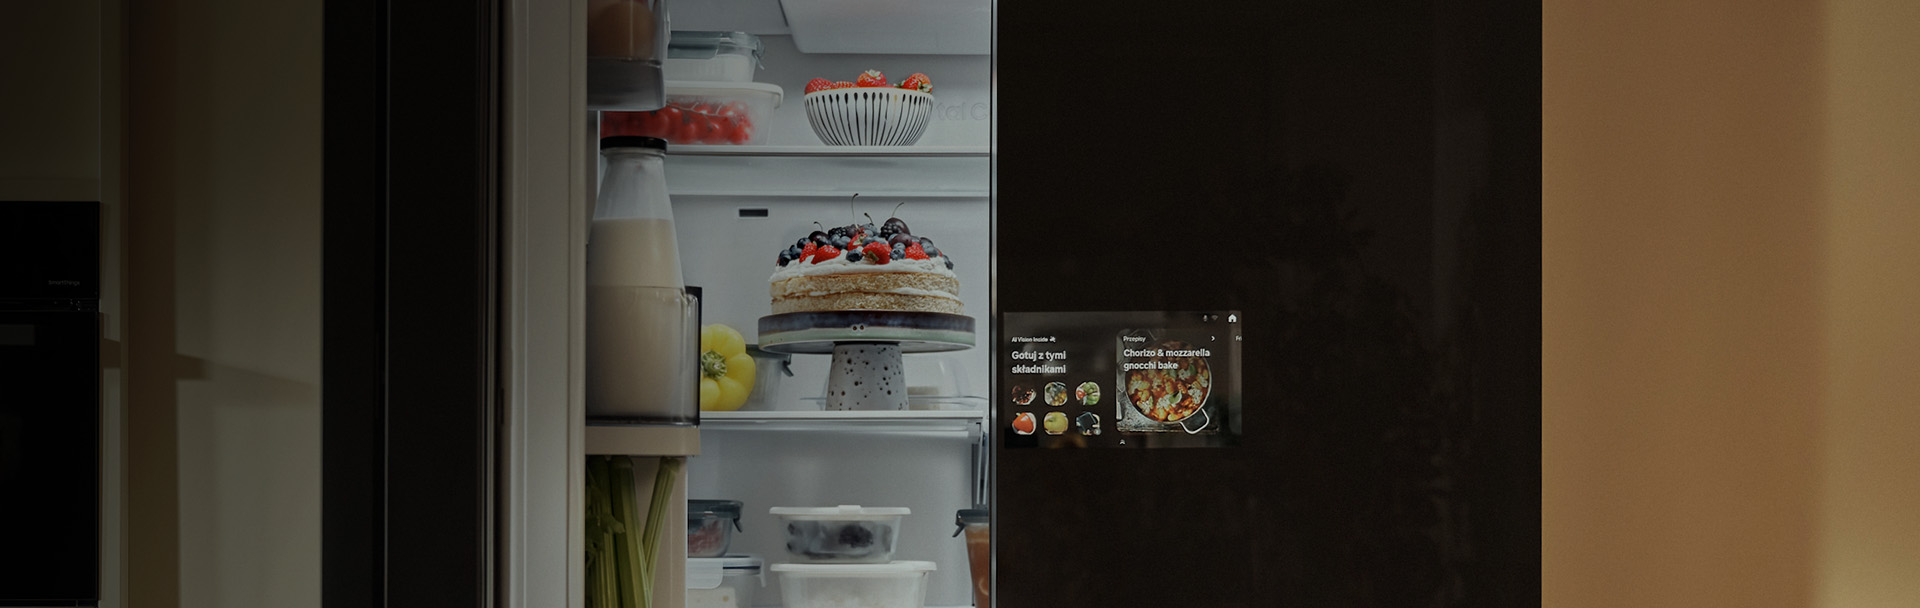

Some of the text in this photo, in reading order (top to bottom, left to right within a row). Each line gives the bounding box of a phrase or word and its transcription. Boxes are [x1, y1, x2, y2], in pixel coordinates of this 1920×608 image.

[1011, 350, 1066, 362] Gotuj z tymi
[1123, 348, 1211, 357] Chorizo & mozzarella
[1011, 364, 1066, 374] składnikami
[1123, 361, 1179, 371] gnocchi bake
